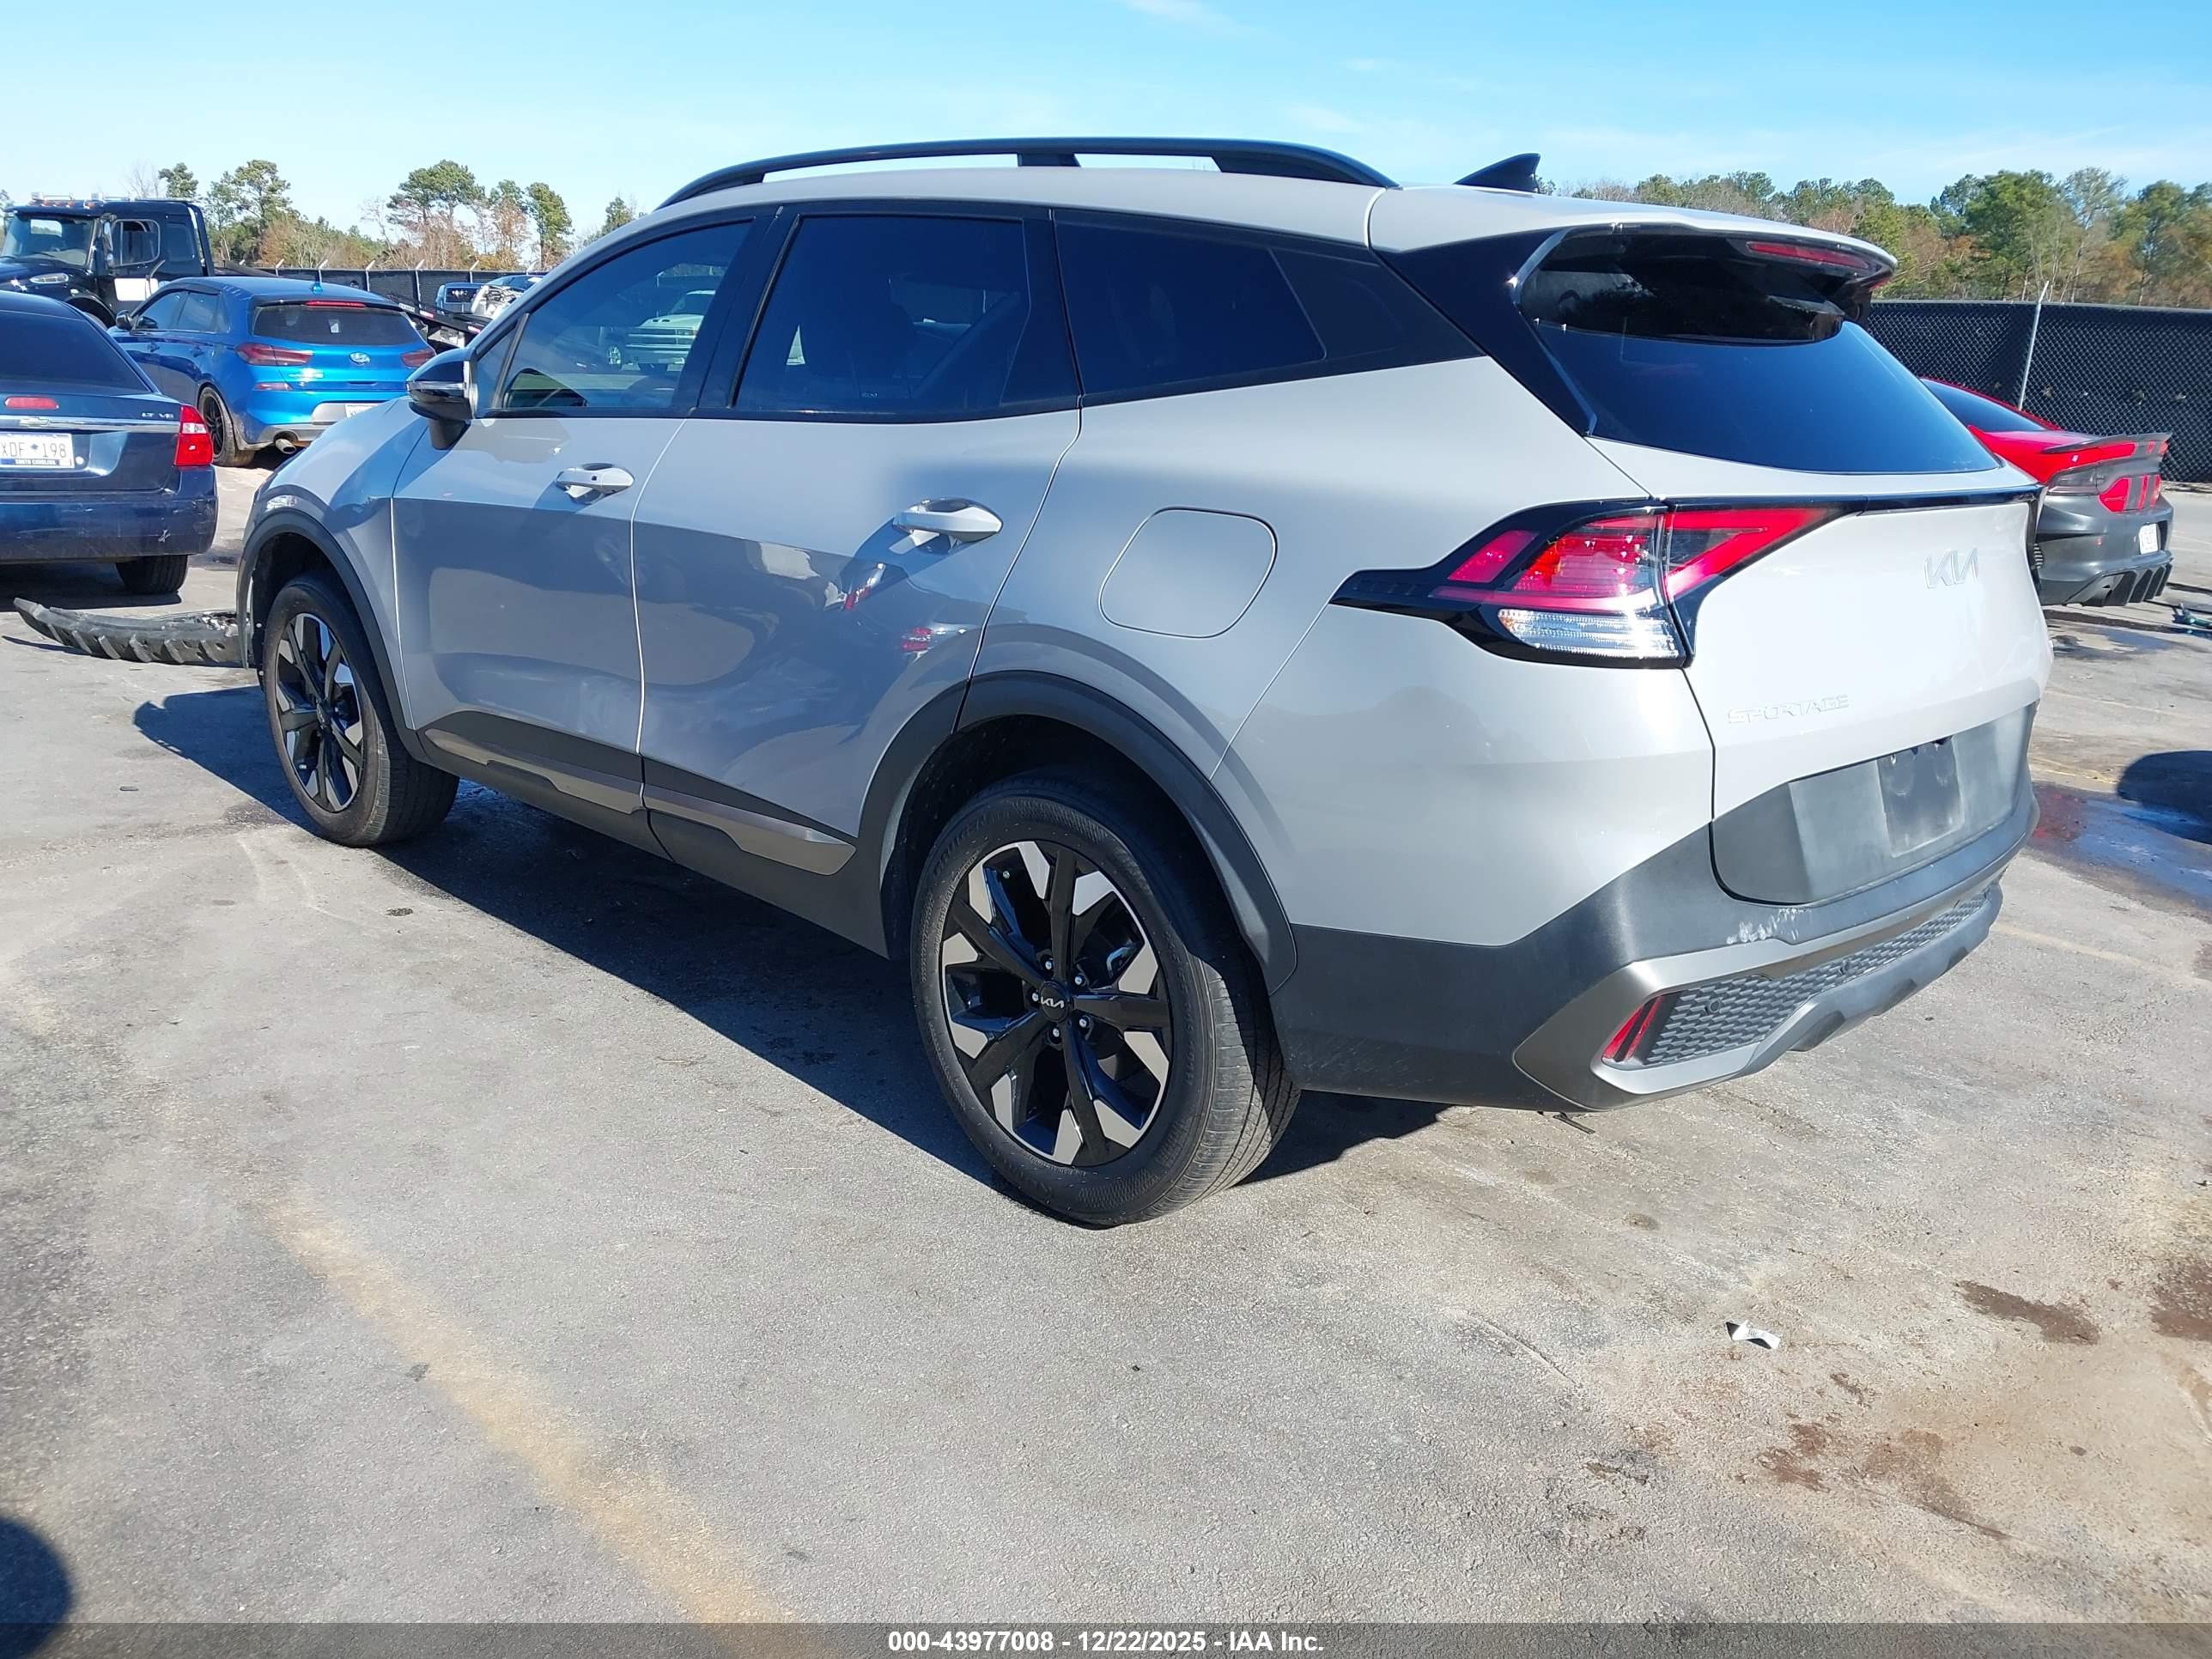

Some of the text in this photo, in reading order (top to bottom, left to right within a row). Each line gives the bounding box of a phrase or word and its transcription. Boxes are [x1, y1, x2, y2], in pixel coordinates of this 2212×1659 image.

[1, 441, 67, 459] XDF 198
[1923, 548, 1978, 589] KIA
[1725, 694, 1849, 725] SPORTAGE
[1040, 996, 1065, 1009] KIA
